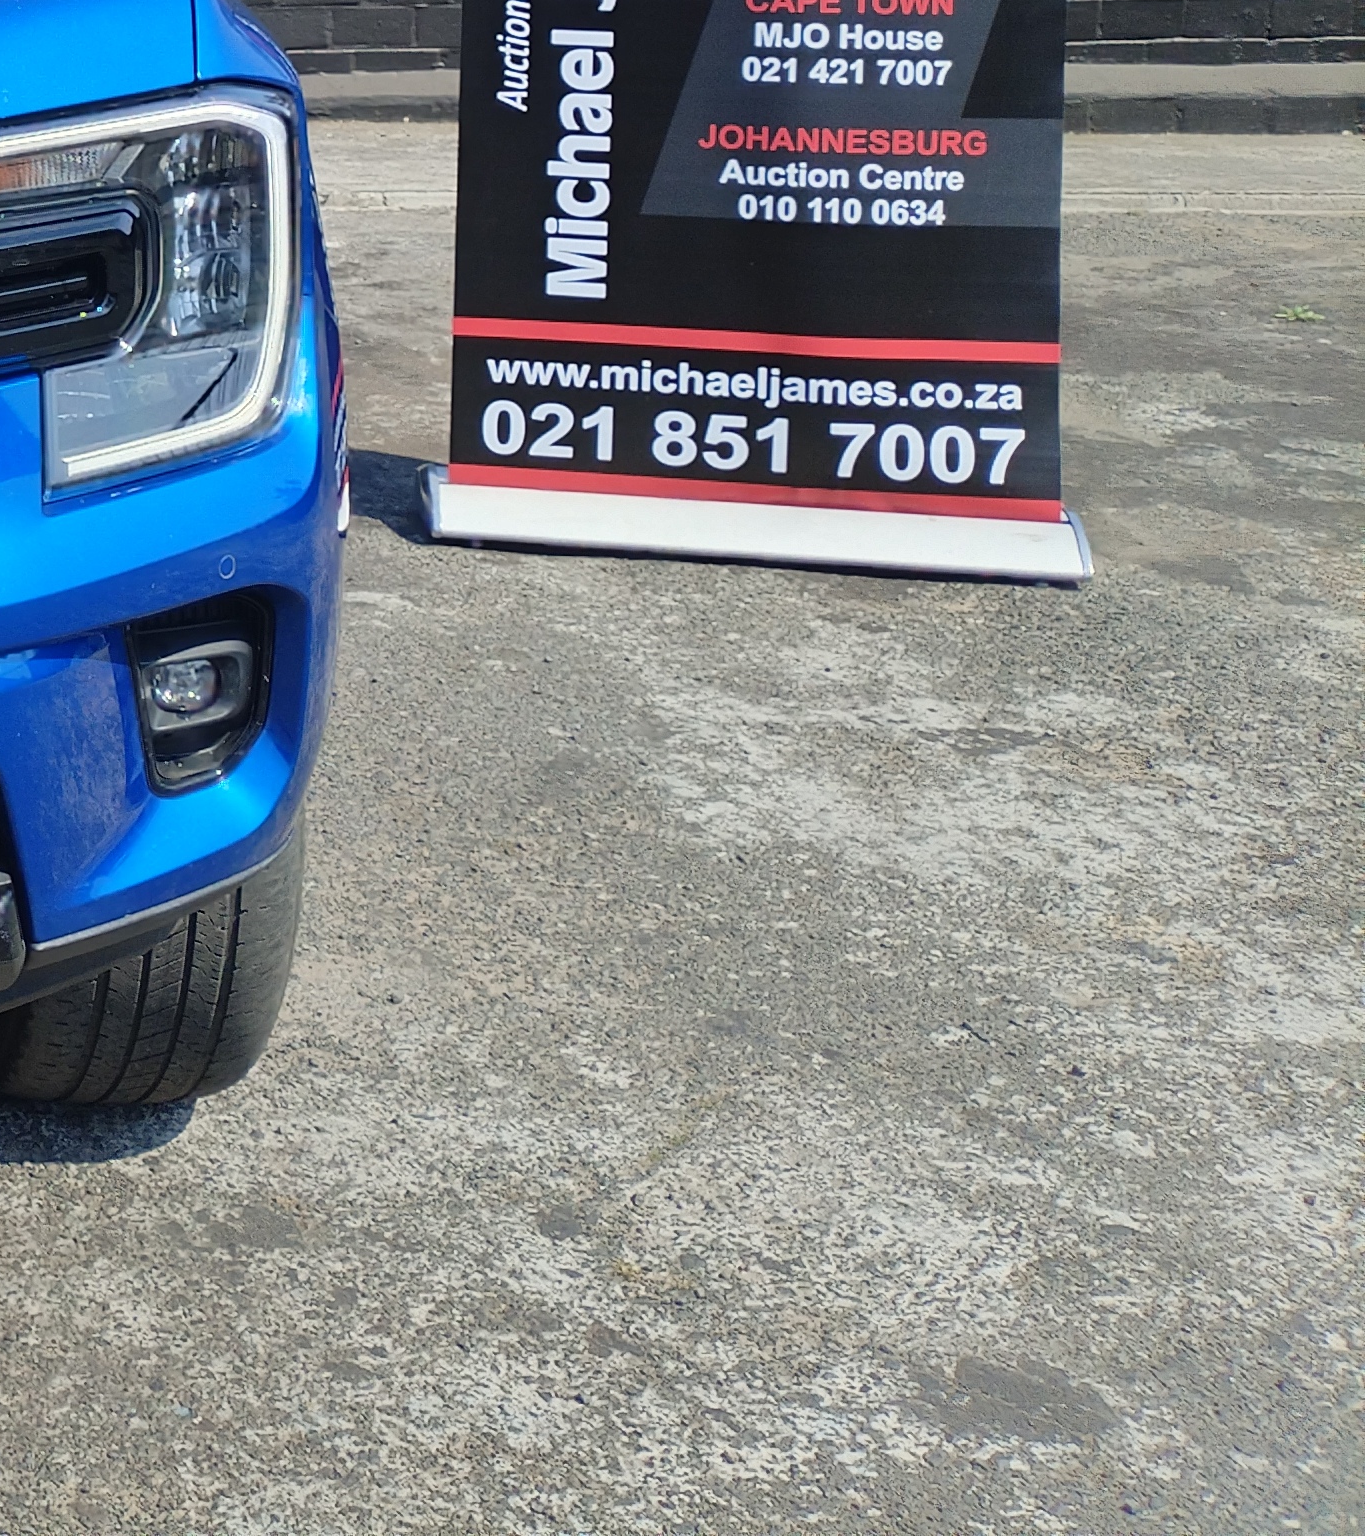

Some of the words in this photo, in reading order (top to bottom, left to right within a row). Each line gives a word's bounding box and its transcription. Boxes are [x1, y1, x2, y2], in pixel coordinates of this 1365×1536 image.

[755, 21, 830, 49] MJO
[839, 23, 944, 51] House
[742, 56, 797, 83] 021
[808, 57, 864, 85] 421
[876, 59, 953, 86] 7007
[699, 124, 987, 156] JOHANNESBURG
[545, 29, 614, 299] Michael
[719, 158, 850, 189] Auction
[859, 163, 965, 192] Centre
[738, 194, 797, 222] 010
[807, 197, 863, 225] 110
[871, 198, 947, 226] 0634
[486, 358, 1023, 411] www.michaeljames.co.za
[482, 399, 614, 462] 021
[652, 410, 789, 473] 851
[829, 421, 1026, 486] 7007
